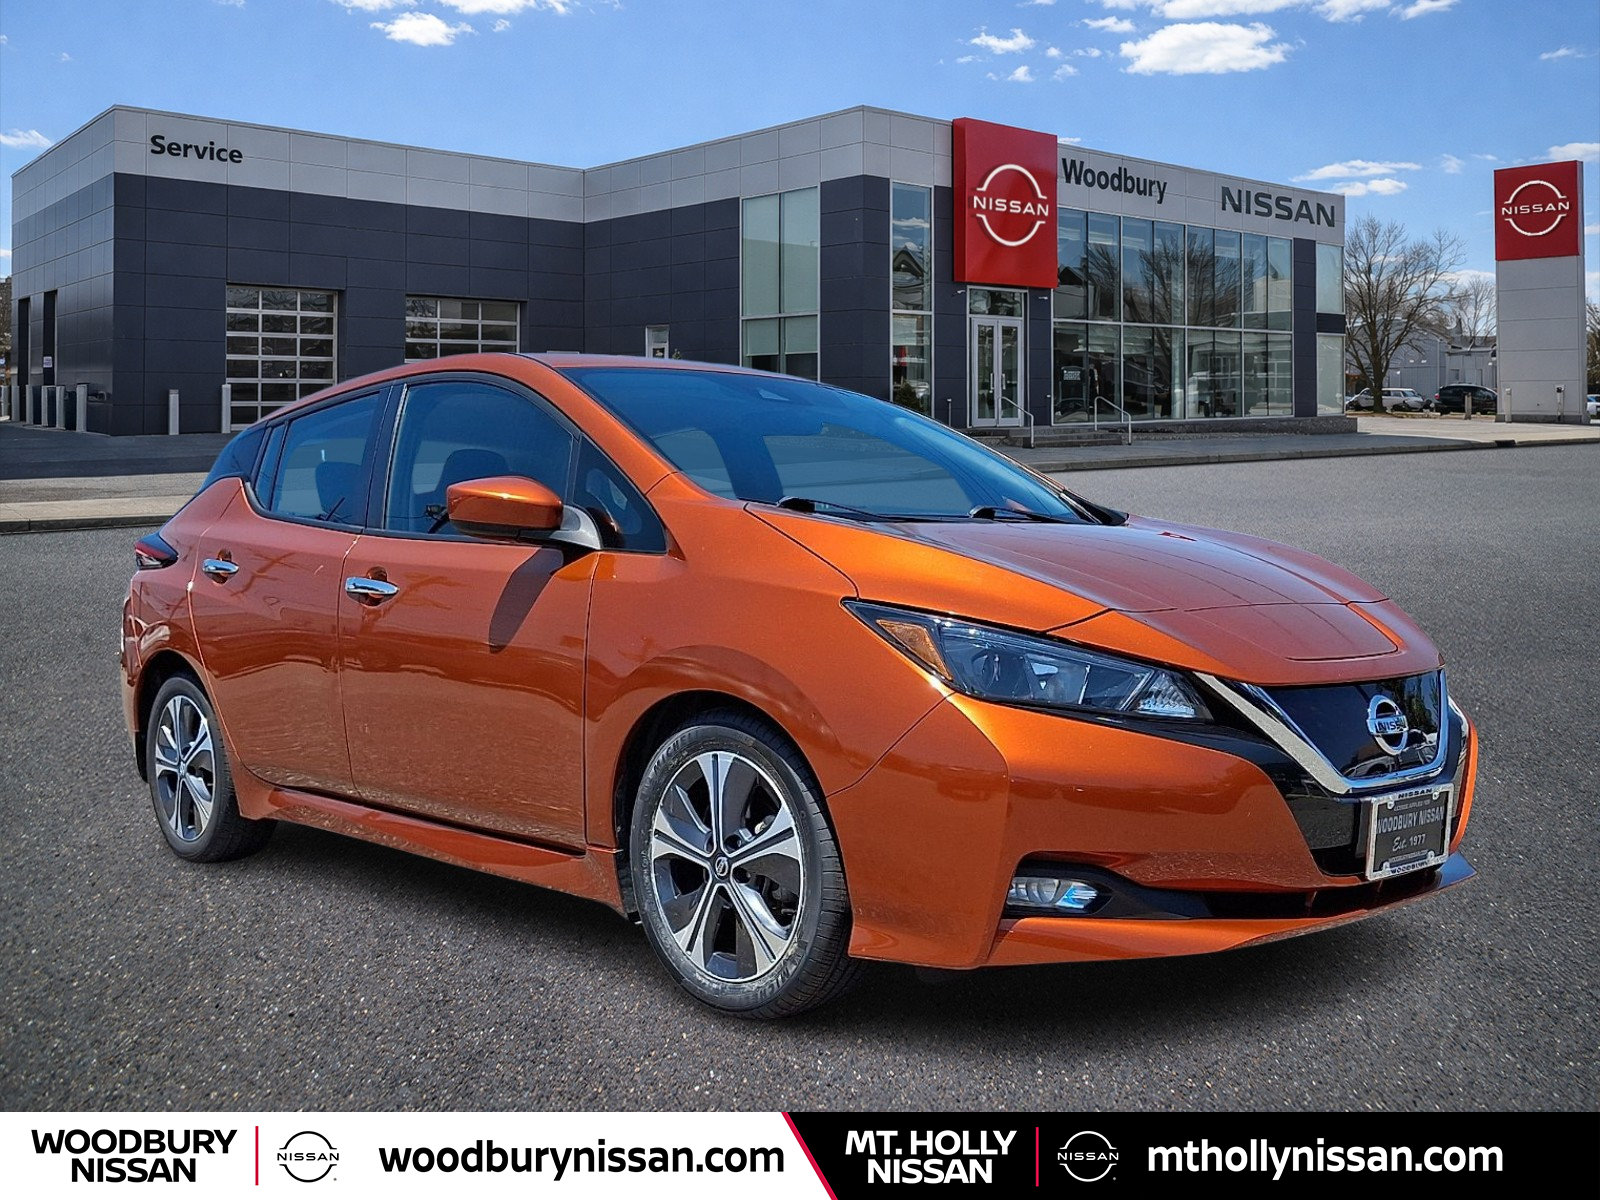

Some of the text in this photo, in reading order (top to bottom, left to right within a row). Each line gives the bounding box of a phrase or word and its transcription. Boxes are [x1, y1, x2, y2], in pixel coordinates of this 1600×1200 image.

[150, 134, 244, 164] Service
[1061, 157, 1168, 205] Woodbury
[972, 195, 1049, 217] NISSAN
[1221, 186, 1336, 228] NISSAN
[1501, 201, 1570, 216] NISSAN
[1398, 788, 1433, 799] NISSAN
[1377, 806, 1445, 834] WOODBURY NISSAN
[1409, 833, 1426, 847] 1977
